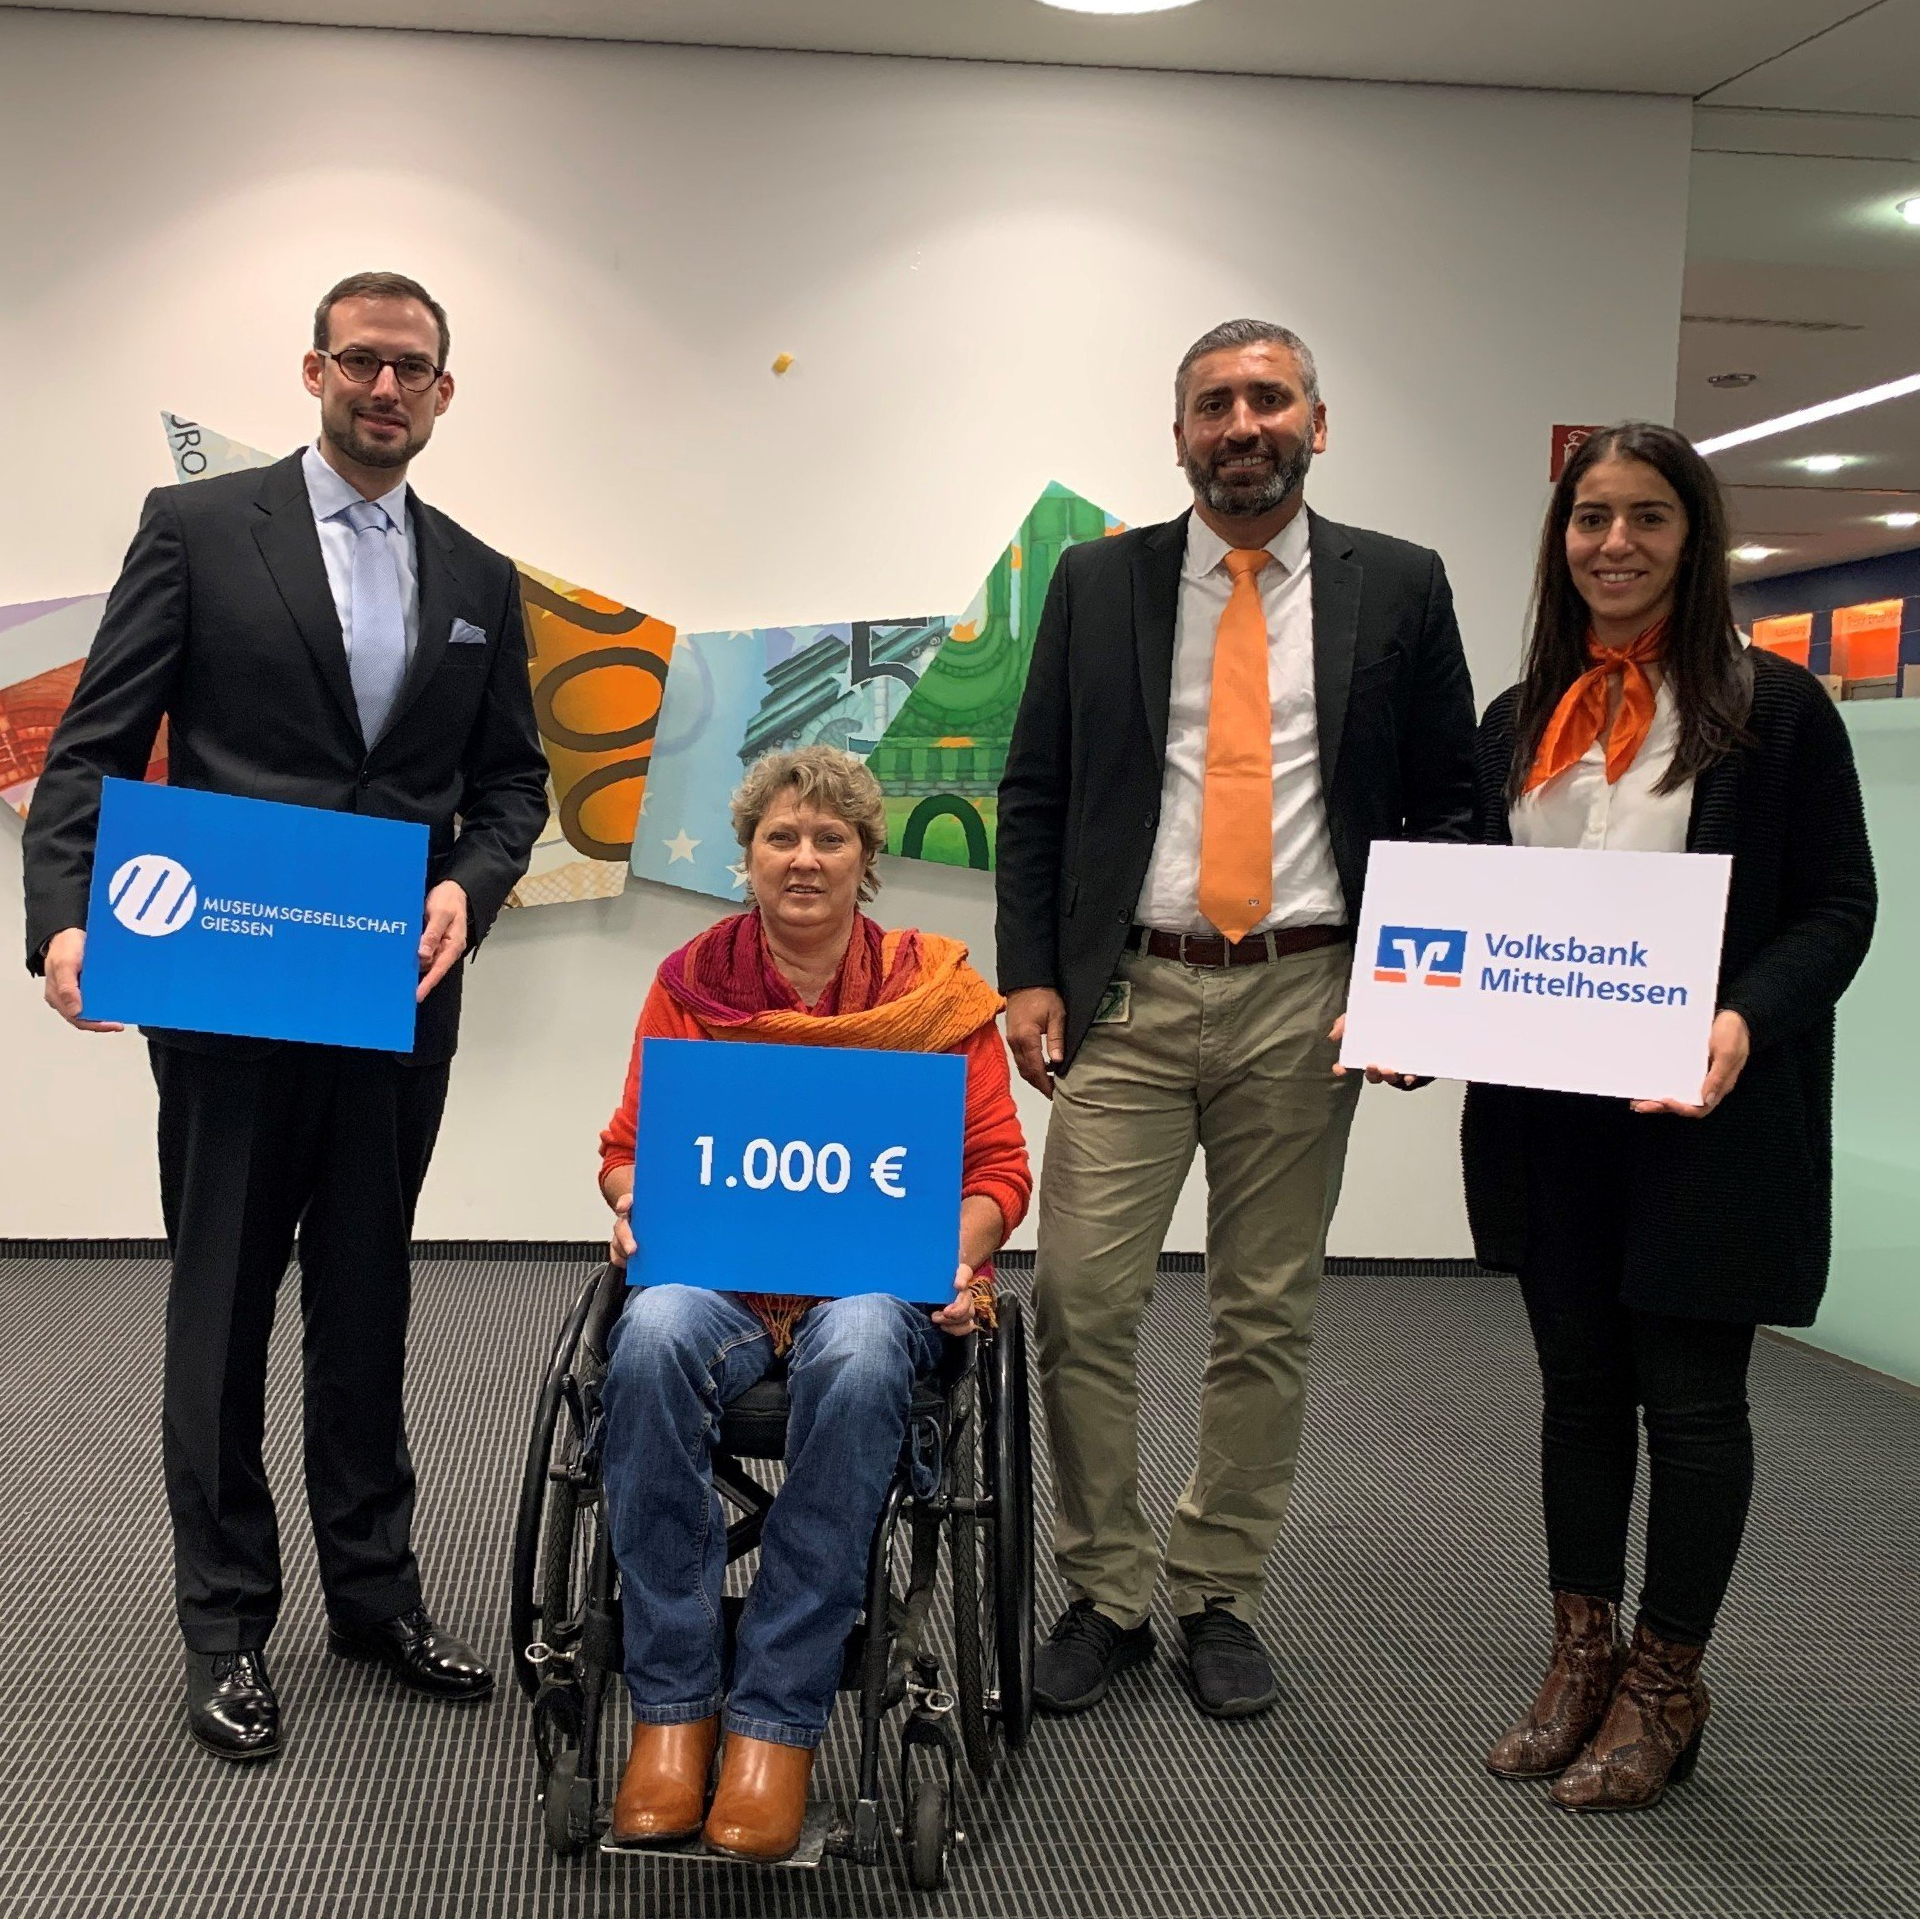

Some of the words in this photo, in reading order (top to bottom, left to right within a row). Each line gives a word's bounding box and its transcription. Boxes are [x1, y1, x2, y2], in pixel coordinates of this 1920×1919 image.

[200, 915, 275, 938] GIESSEN
[202, 897, 408, 935] MUSEUMSGESELLSCHAFT
[1485, 933, 1649, 968] Volksbank
[1480, 967, 1688, 1006] Mittelhessen
[693, 1135, 851, 1194] 1.000
[869, 1146, 908, 1198] €
